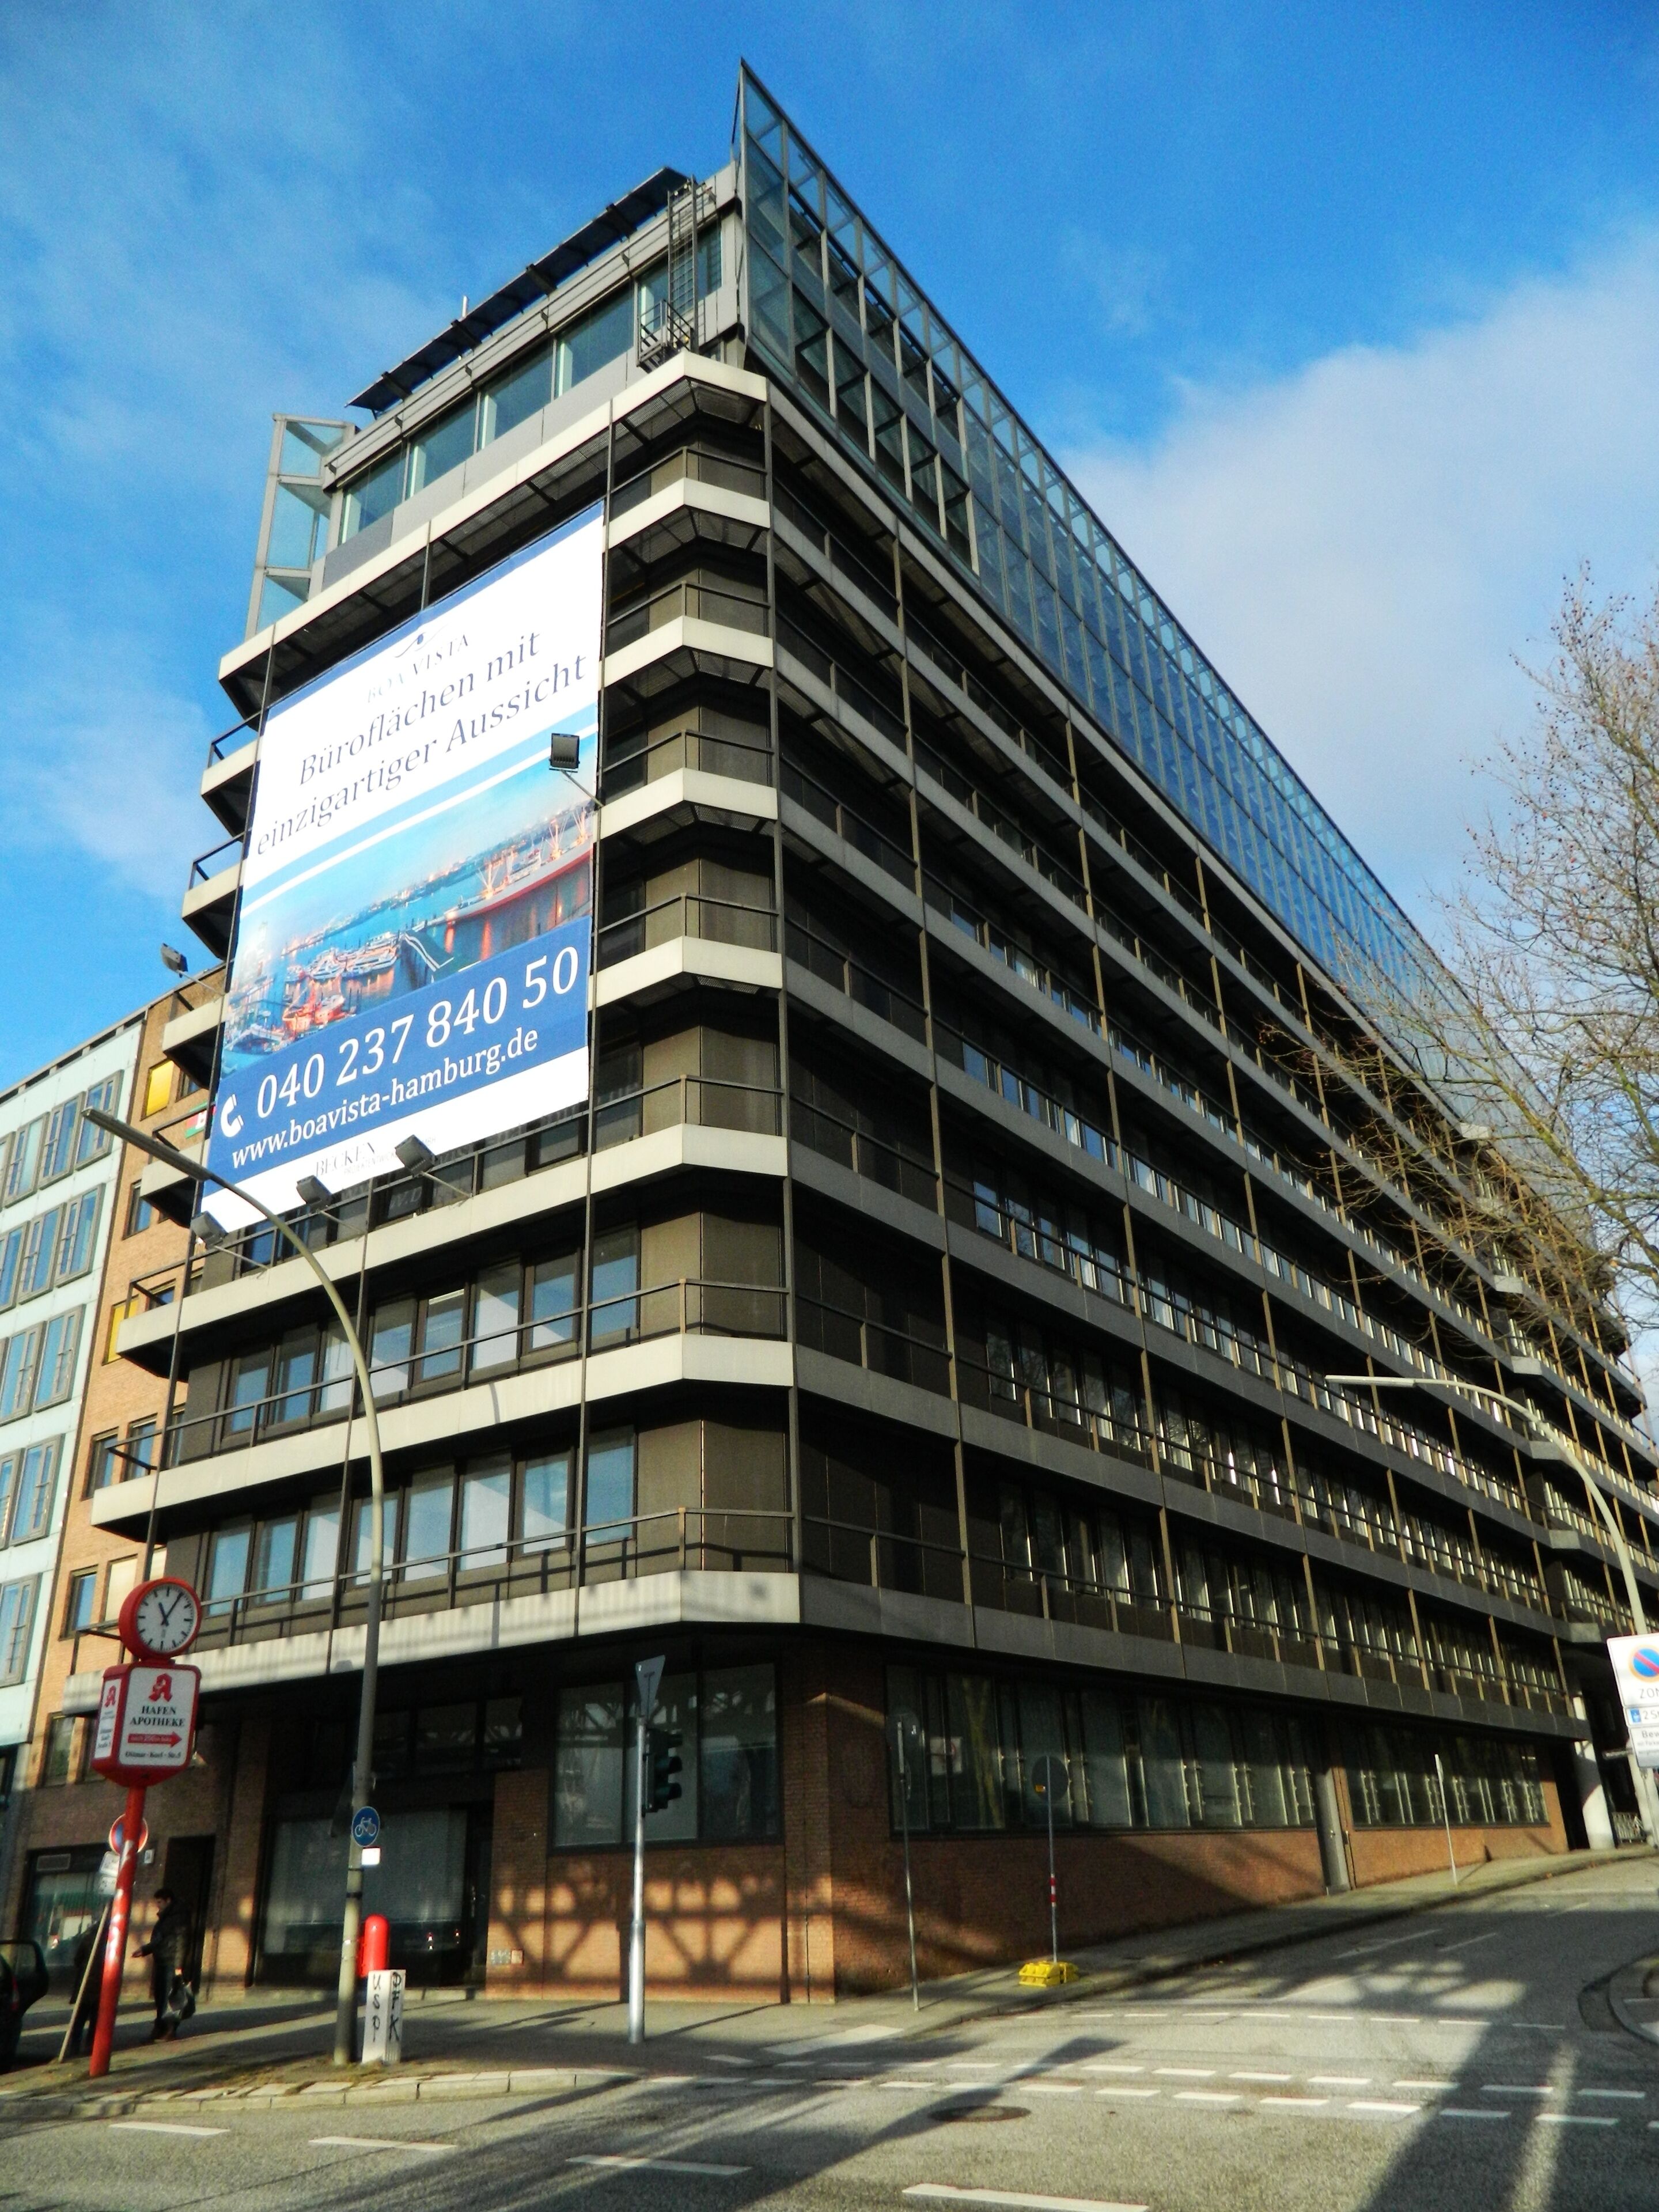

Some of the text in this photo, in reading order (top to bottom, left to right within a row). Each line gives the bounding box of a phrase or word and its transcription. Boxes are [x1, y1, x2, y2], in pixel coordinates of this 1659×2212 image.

[412, 634, 468, 676] VISTA
[257, 655, 586, 855] einzigartiger Aussicht
[299, 632, 540, 786] Büroflächen mit
[256, 946, 578, 1119] 040 237 840 50
[232, 1027, 539, 1169] www.boavista-hamburg.de
[315, 1142, 378, 1177] BECKEN
[130, 1716, 185, 1728] APOTHEKE
[141, 1705, 177, 1715] HAFEN
